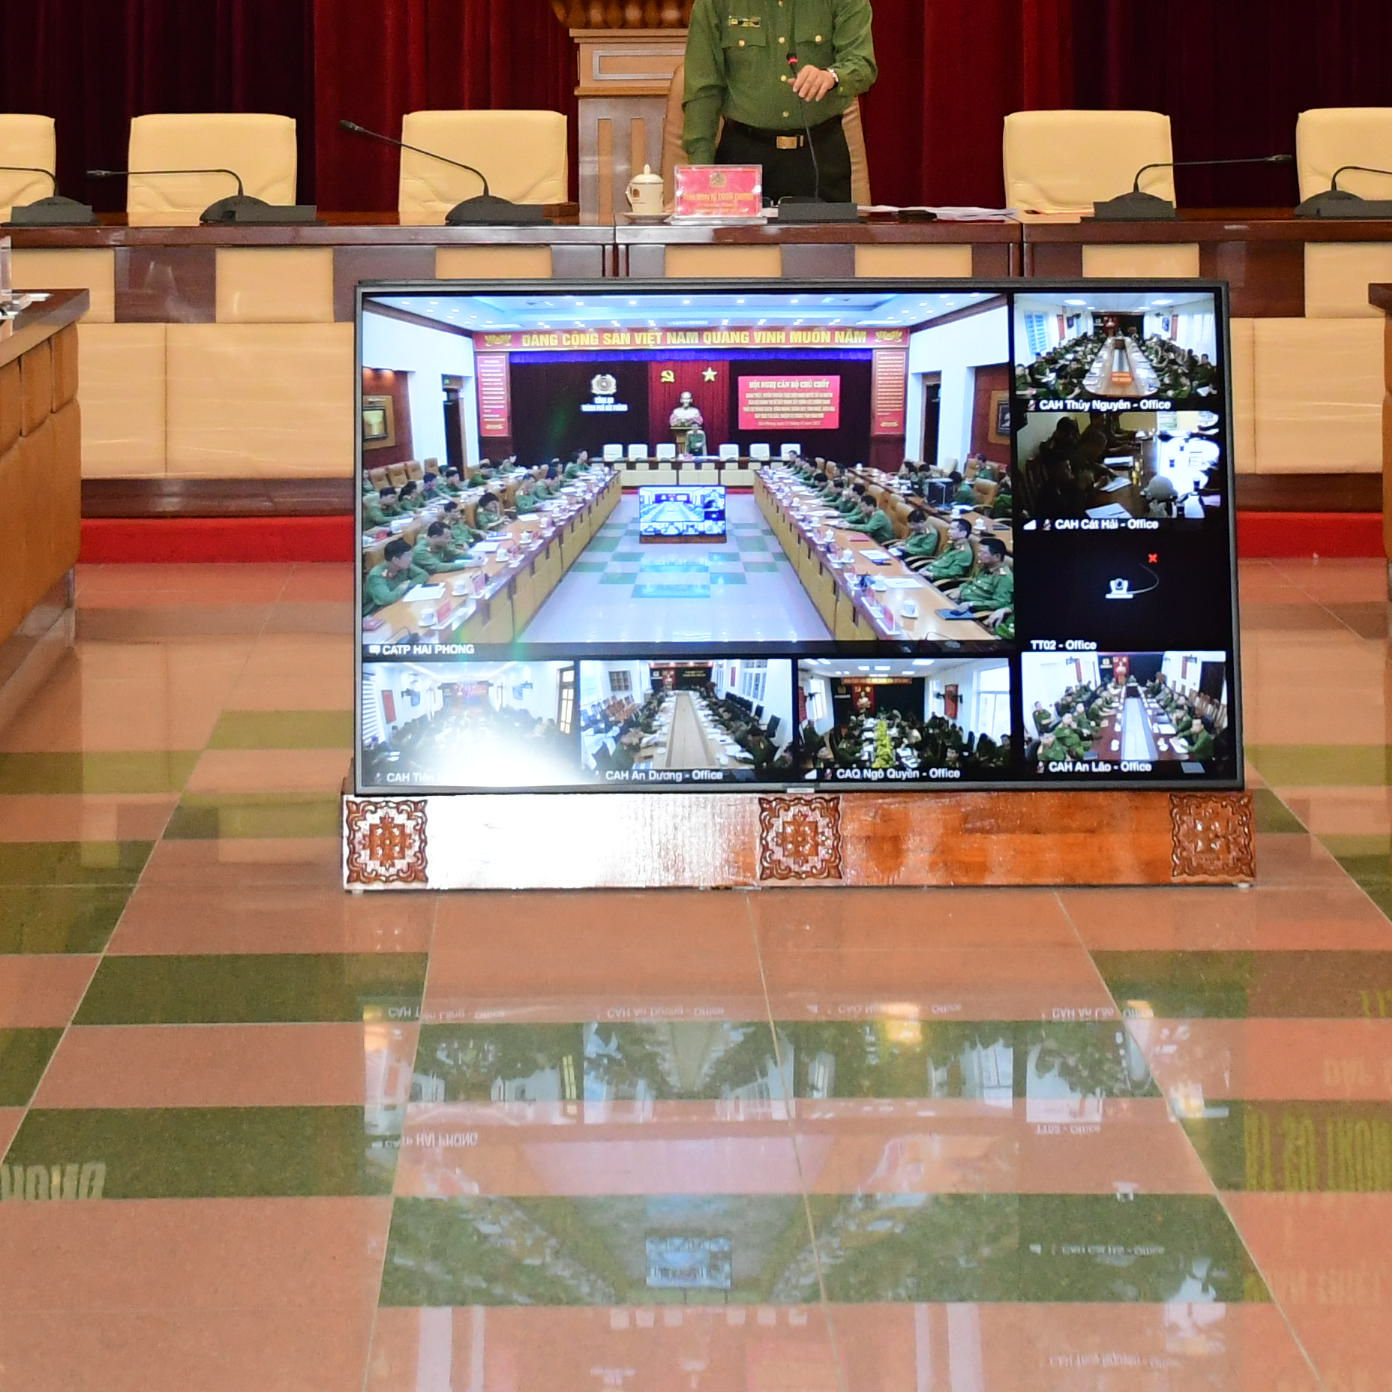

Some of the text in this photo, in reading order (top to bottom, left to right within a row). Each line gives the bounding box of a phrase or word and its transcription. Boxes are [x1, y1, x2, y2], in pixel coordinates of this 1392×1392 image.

[667, 331, 785, 345] NAM QUANG VINH
[1039, 399, 1171, 410] CAH Office
[1055, 519, 1079, 530] CAH
[1127, 519, 1159, 530] Office
[382, 644, 476, 655] CATP HAI PHONG
[1031, 640, 1097, 650] TT02 Office
[1048, 761, 1073, 772] CAH
[1074, 762, 1090, 772] An
[1120, 761, 1152, 772] Office
[387, 772, 411, 783] CAH
[605, 770, 629, 781] CAH
[631, 770, 646, 781] An
[692, 769, 723, 781] Office
[836, 768, 861, 779] CAQ
[863, 768, 885, 781] Ngô
[929, 768, 961, 779] Office
